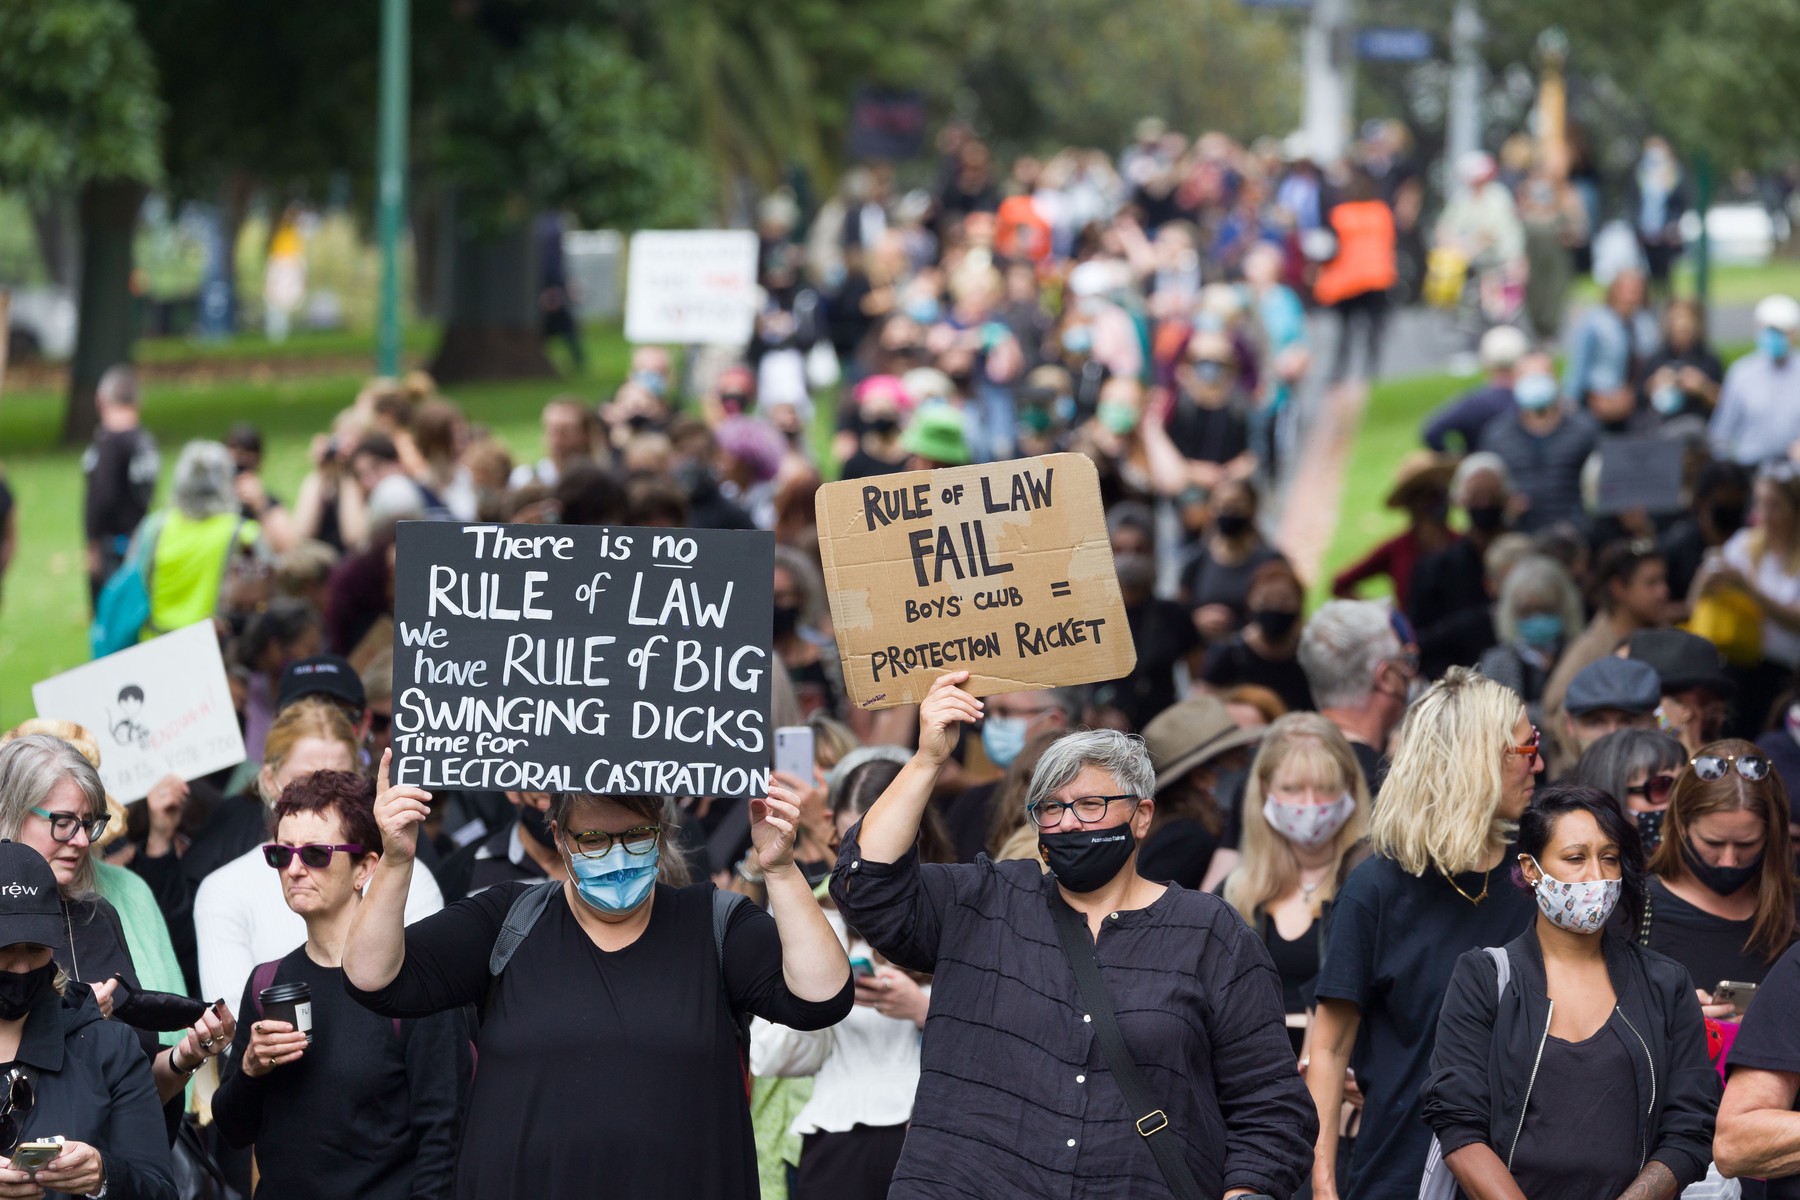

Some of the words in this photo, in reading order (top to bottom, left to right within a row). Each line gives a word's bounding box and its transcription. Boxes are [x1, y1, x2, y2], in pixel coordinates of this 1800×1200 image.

[863, 484, 932, 531] RULE
[942, 484, 964, 505] OF
[980, 468, 1054, 514] LAW
[463, 525, 574, 560] There
[600, 528, 633, 561] is
[652, 535, 698, 563] no
[908, 519, 1014, 587] FAIL
[428, 564, 553, 621] RULE
[575, 571, 612, 614] of
[628, 572, 734, 628] LAW
[973, 586, 1024, 610] CLUB
[1050, 581, 1072, 597] =
[400, 621, 449, 648] We
[413, 649, 488, 687] have
[503, 633, 616, 686] RULE
[627, 635, 669, 690] of
[674, 640, 765, 693] BIG
[871, 632, 1001, 683] PROTECTION
[1014, 617, 1106, 659] RACKET
[395, 687, 611, 736] SWINGING
[632, 701, 764, 753] DICKS
[395, 732, 470, 754] Time
[475, 731, 529, 756] for
[397, 756, 582, 790] ELECTORAL
[585, 759, 769, 797] CASTRATION
